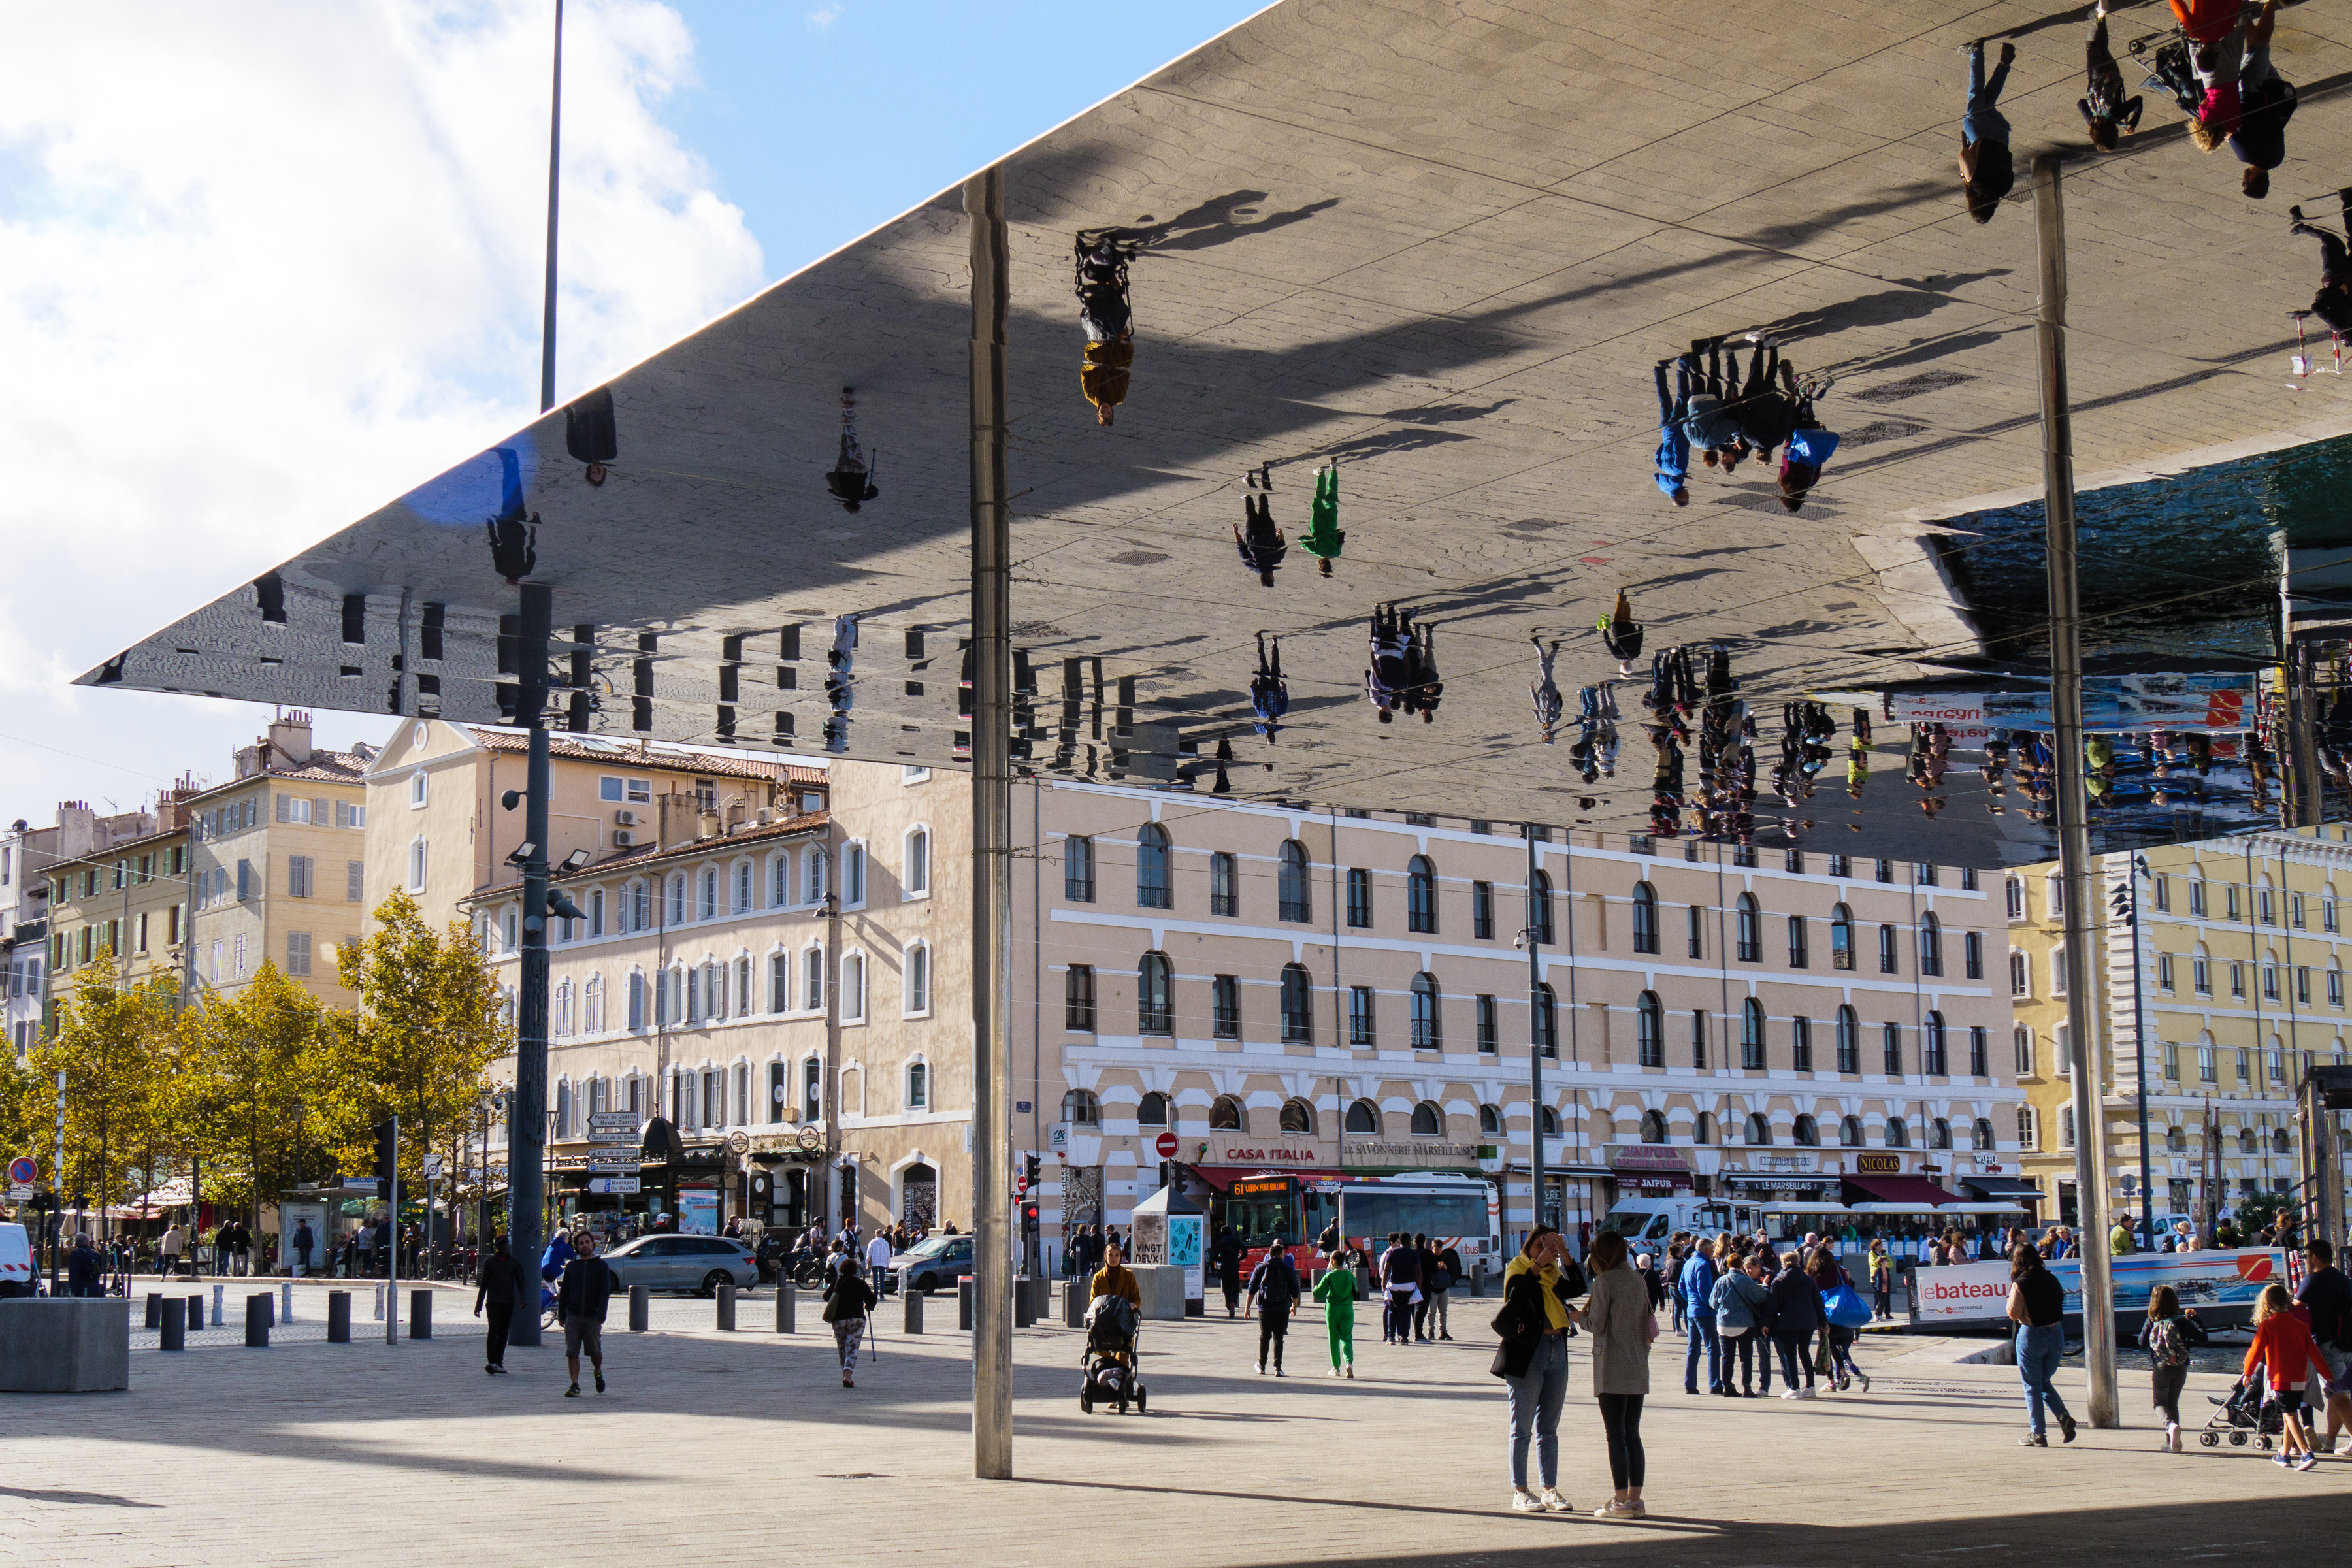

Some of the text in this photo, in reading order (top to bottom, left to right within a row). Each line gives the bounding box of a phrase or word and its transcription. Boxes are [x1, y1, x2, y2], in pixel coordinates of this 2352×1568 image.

[1227, 1149, 1315, 1160] CASA ITALIA
[1356, 1144, 1412, 1155] SAVONNERIE
[1413, 1145, 1471, 1156] MARSEILLAISE
[1623, 1145, 1678, 1158] JAIPUR
[1616, 1158, 1688, 1169] RESTAURANT INDIEN
[1760, 1156, 1811, 1166] LE MARSEILLAIS
[1861, 1157, 1899, 1170] NICOLAS
[1974, 1154, 1999, 1164] WAFFLE
[1234, 1184, 1244, 1195] 61
[1245, 1184, 1260, 1192] VIEUX
[1270, 1182, 1287, 1191] BALLARD
[1641, 1179, 1672, 1188] JAIPUR
[1771, 1181, 1812, 1190] MARSEILLAIS
[1136, 1243, 1162, 1252] VINGT
[1460, 1244, 1479, 1255] lebus
